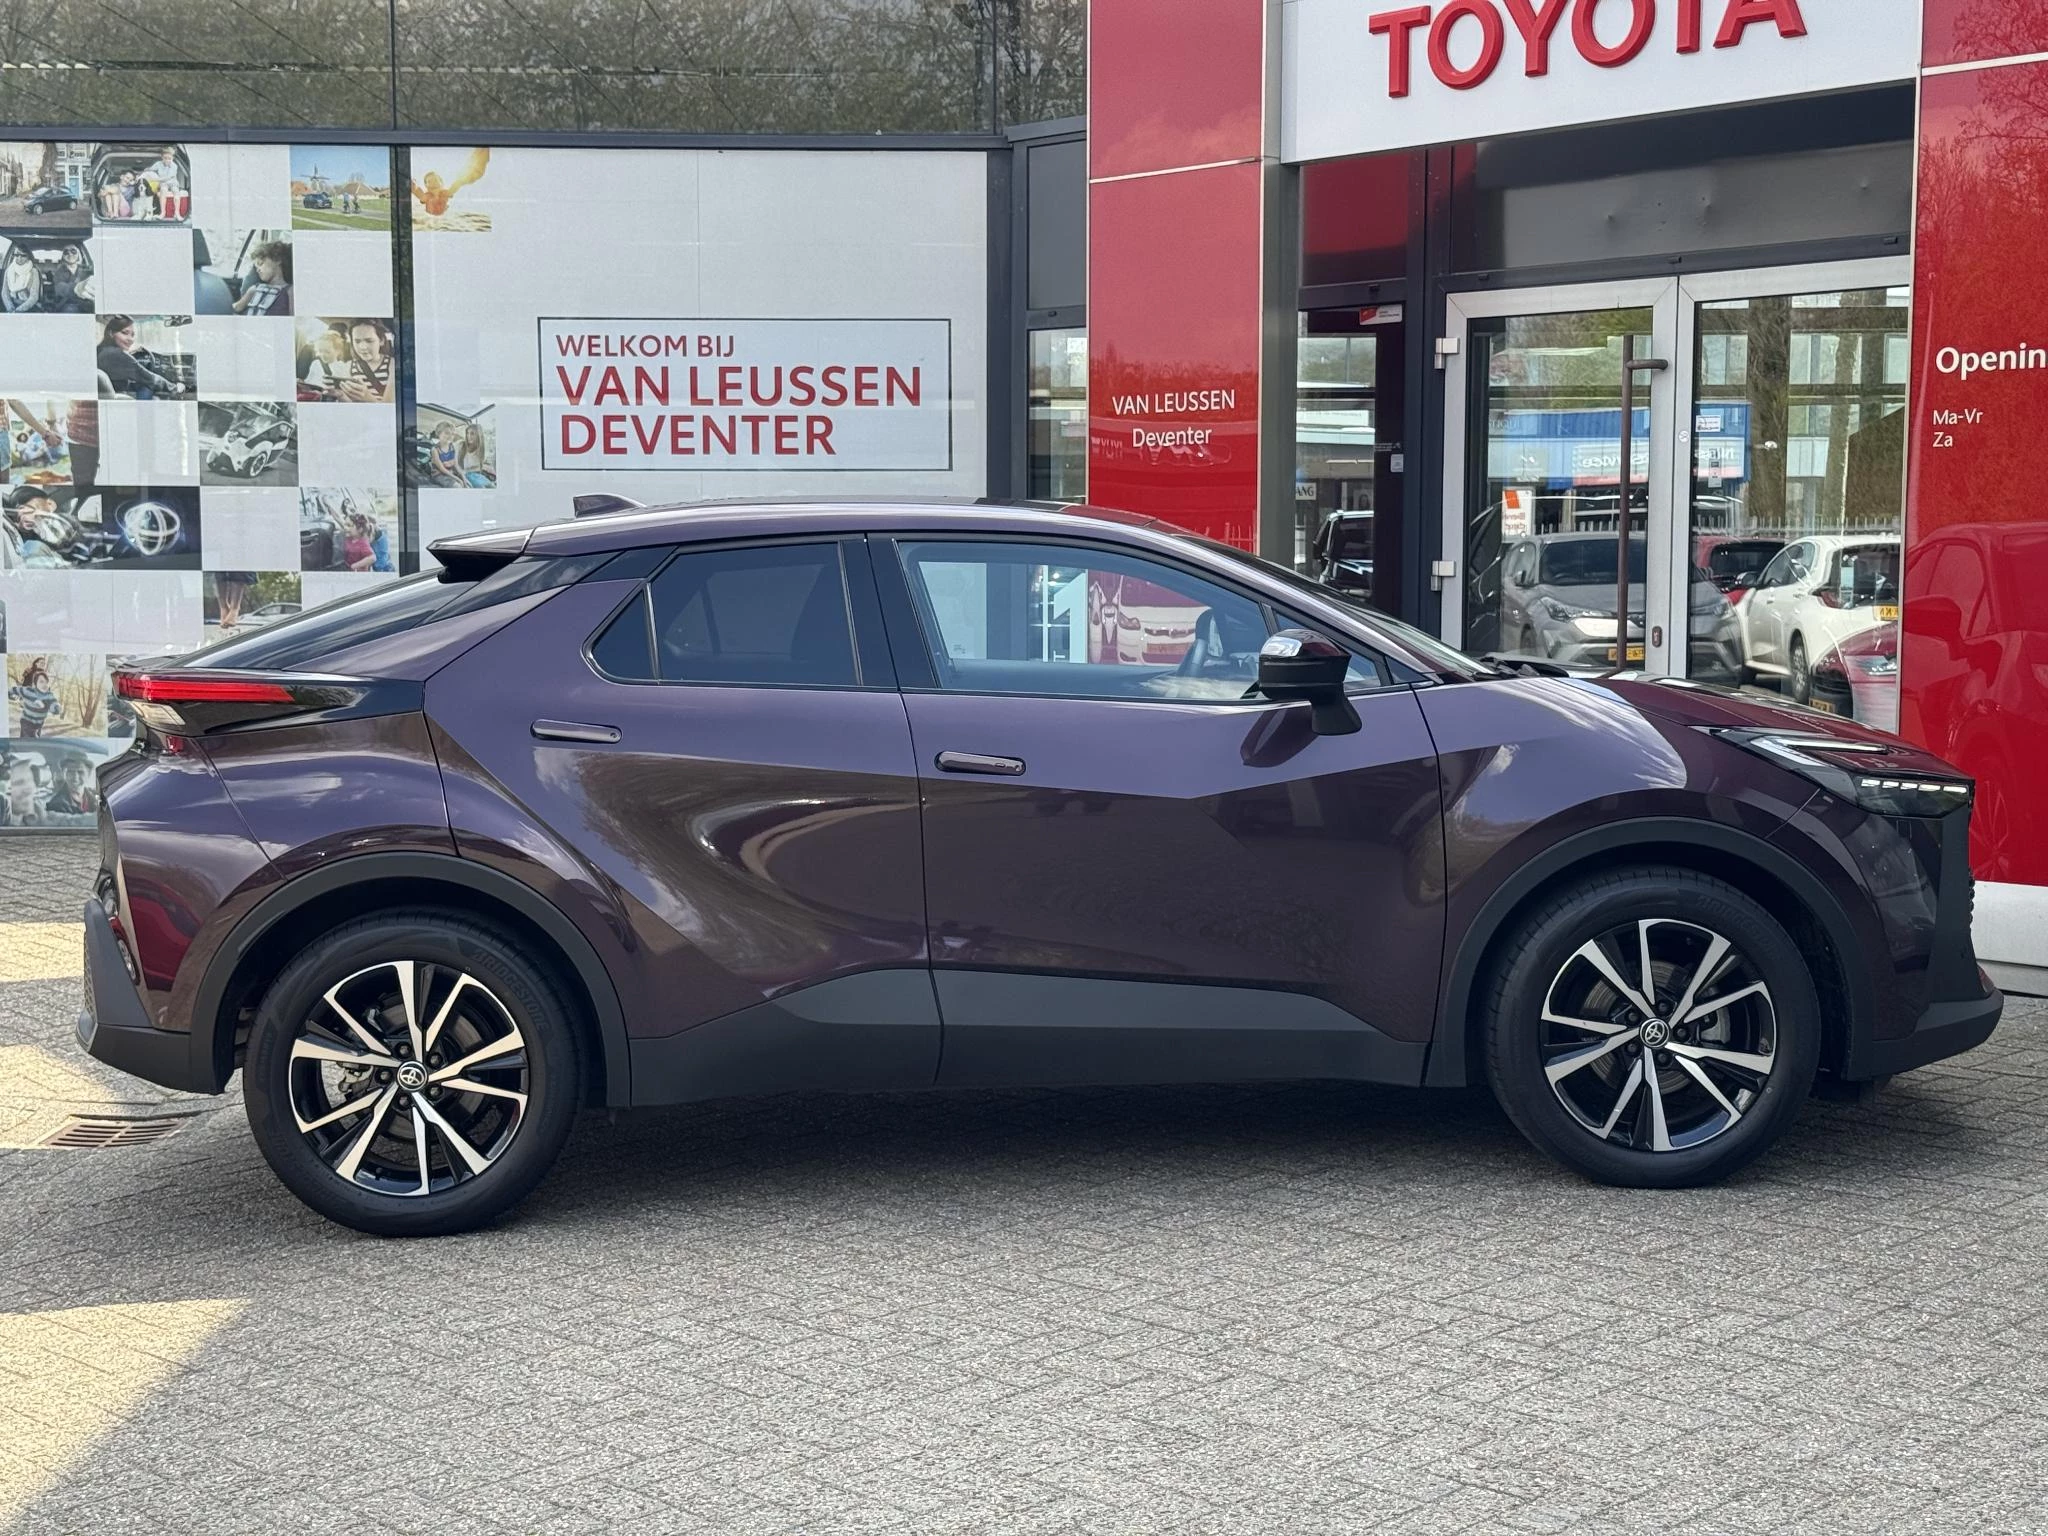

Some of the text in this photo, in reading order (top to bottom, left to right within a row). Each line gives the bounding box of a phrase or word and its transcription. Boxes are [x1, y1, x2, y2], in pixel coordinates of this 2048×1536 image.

[556, 334, 735, 357] WELKOM BIJ
[556, 365, 921, 407] VAN LEUSSEN
[1112, 389, 1236, 415] VAN LEUSSEN
[1932, 408, 1984, 426] Ma-Vr
[561, 414, 837, 455] DEVENTER
[1132, 426, 1212, 448] Deventer
[1932, 431, 1953, 448] Za
